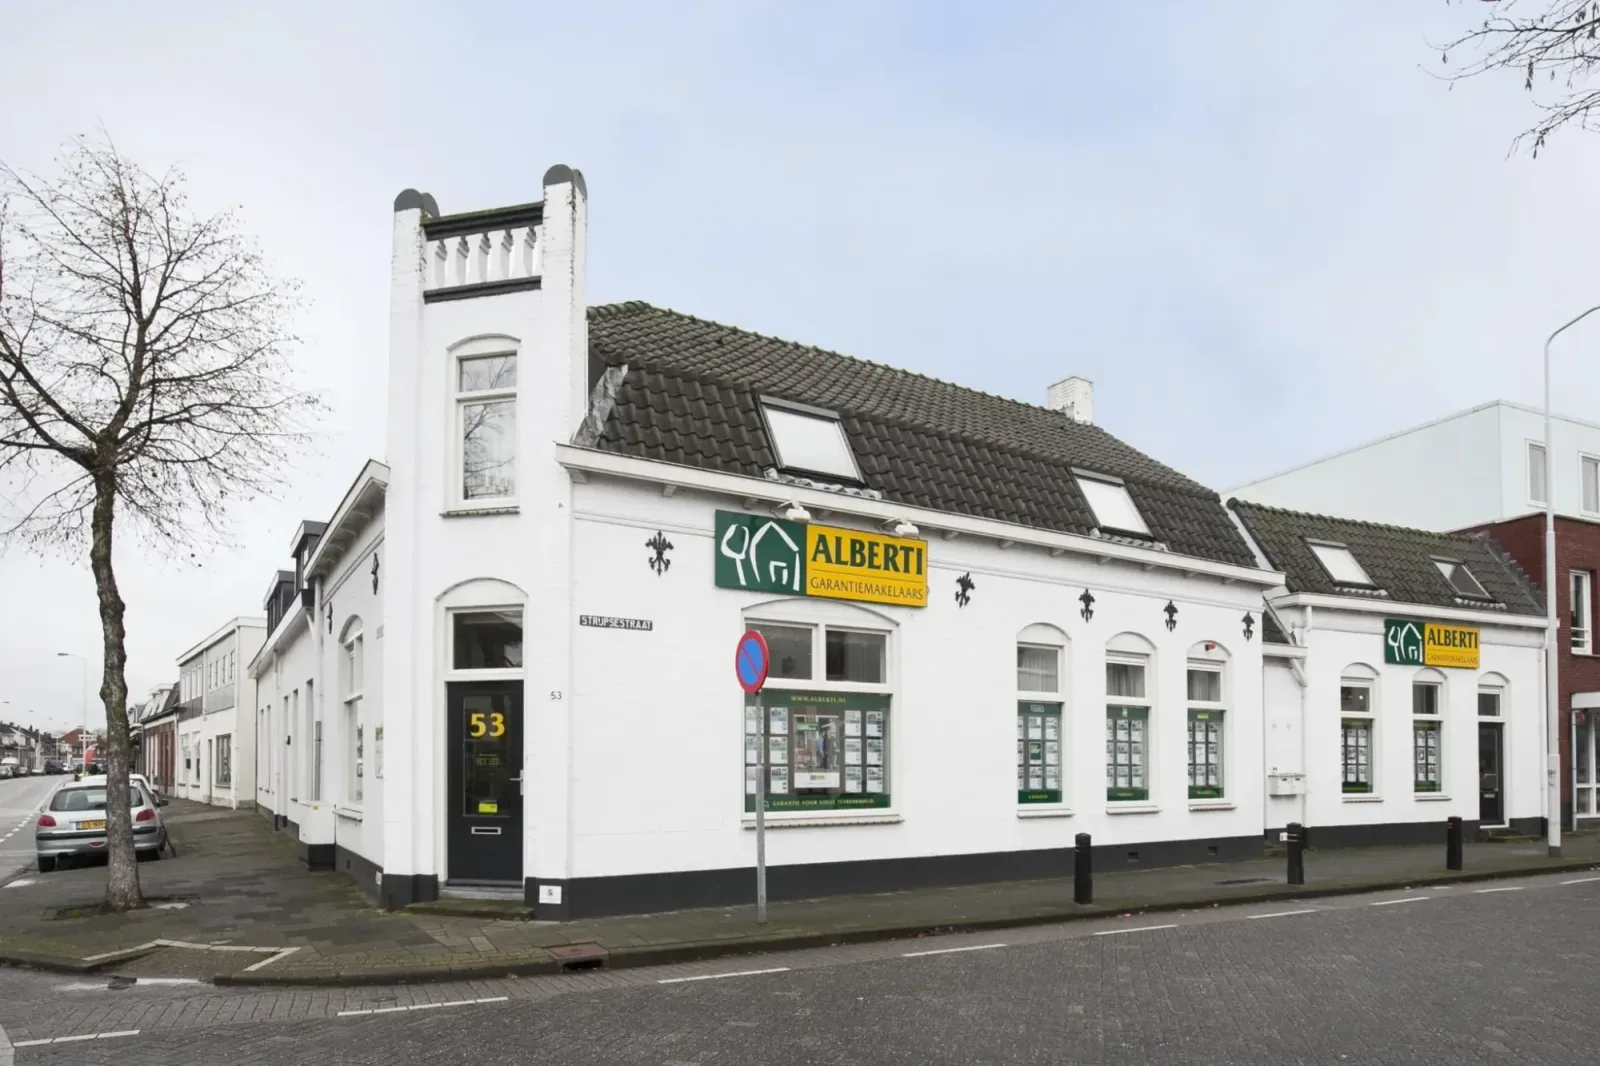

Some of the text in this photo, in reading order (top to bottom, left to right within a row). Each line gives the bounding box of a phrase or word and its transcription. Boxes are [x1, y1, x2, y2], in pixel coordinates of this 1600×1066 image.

[811, 533, 923, 576] ALBERTI
[810, 576, 924, 600] GARANTIEMAKELAARS
[581, 615, 652, 630] STRIJPSESTRAAT
[1427, 627, 1478, 649] ALBERTI
[550, 690, 563, 700] 53
[470, 712, 505, 737] 53
